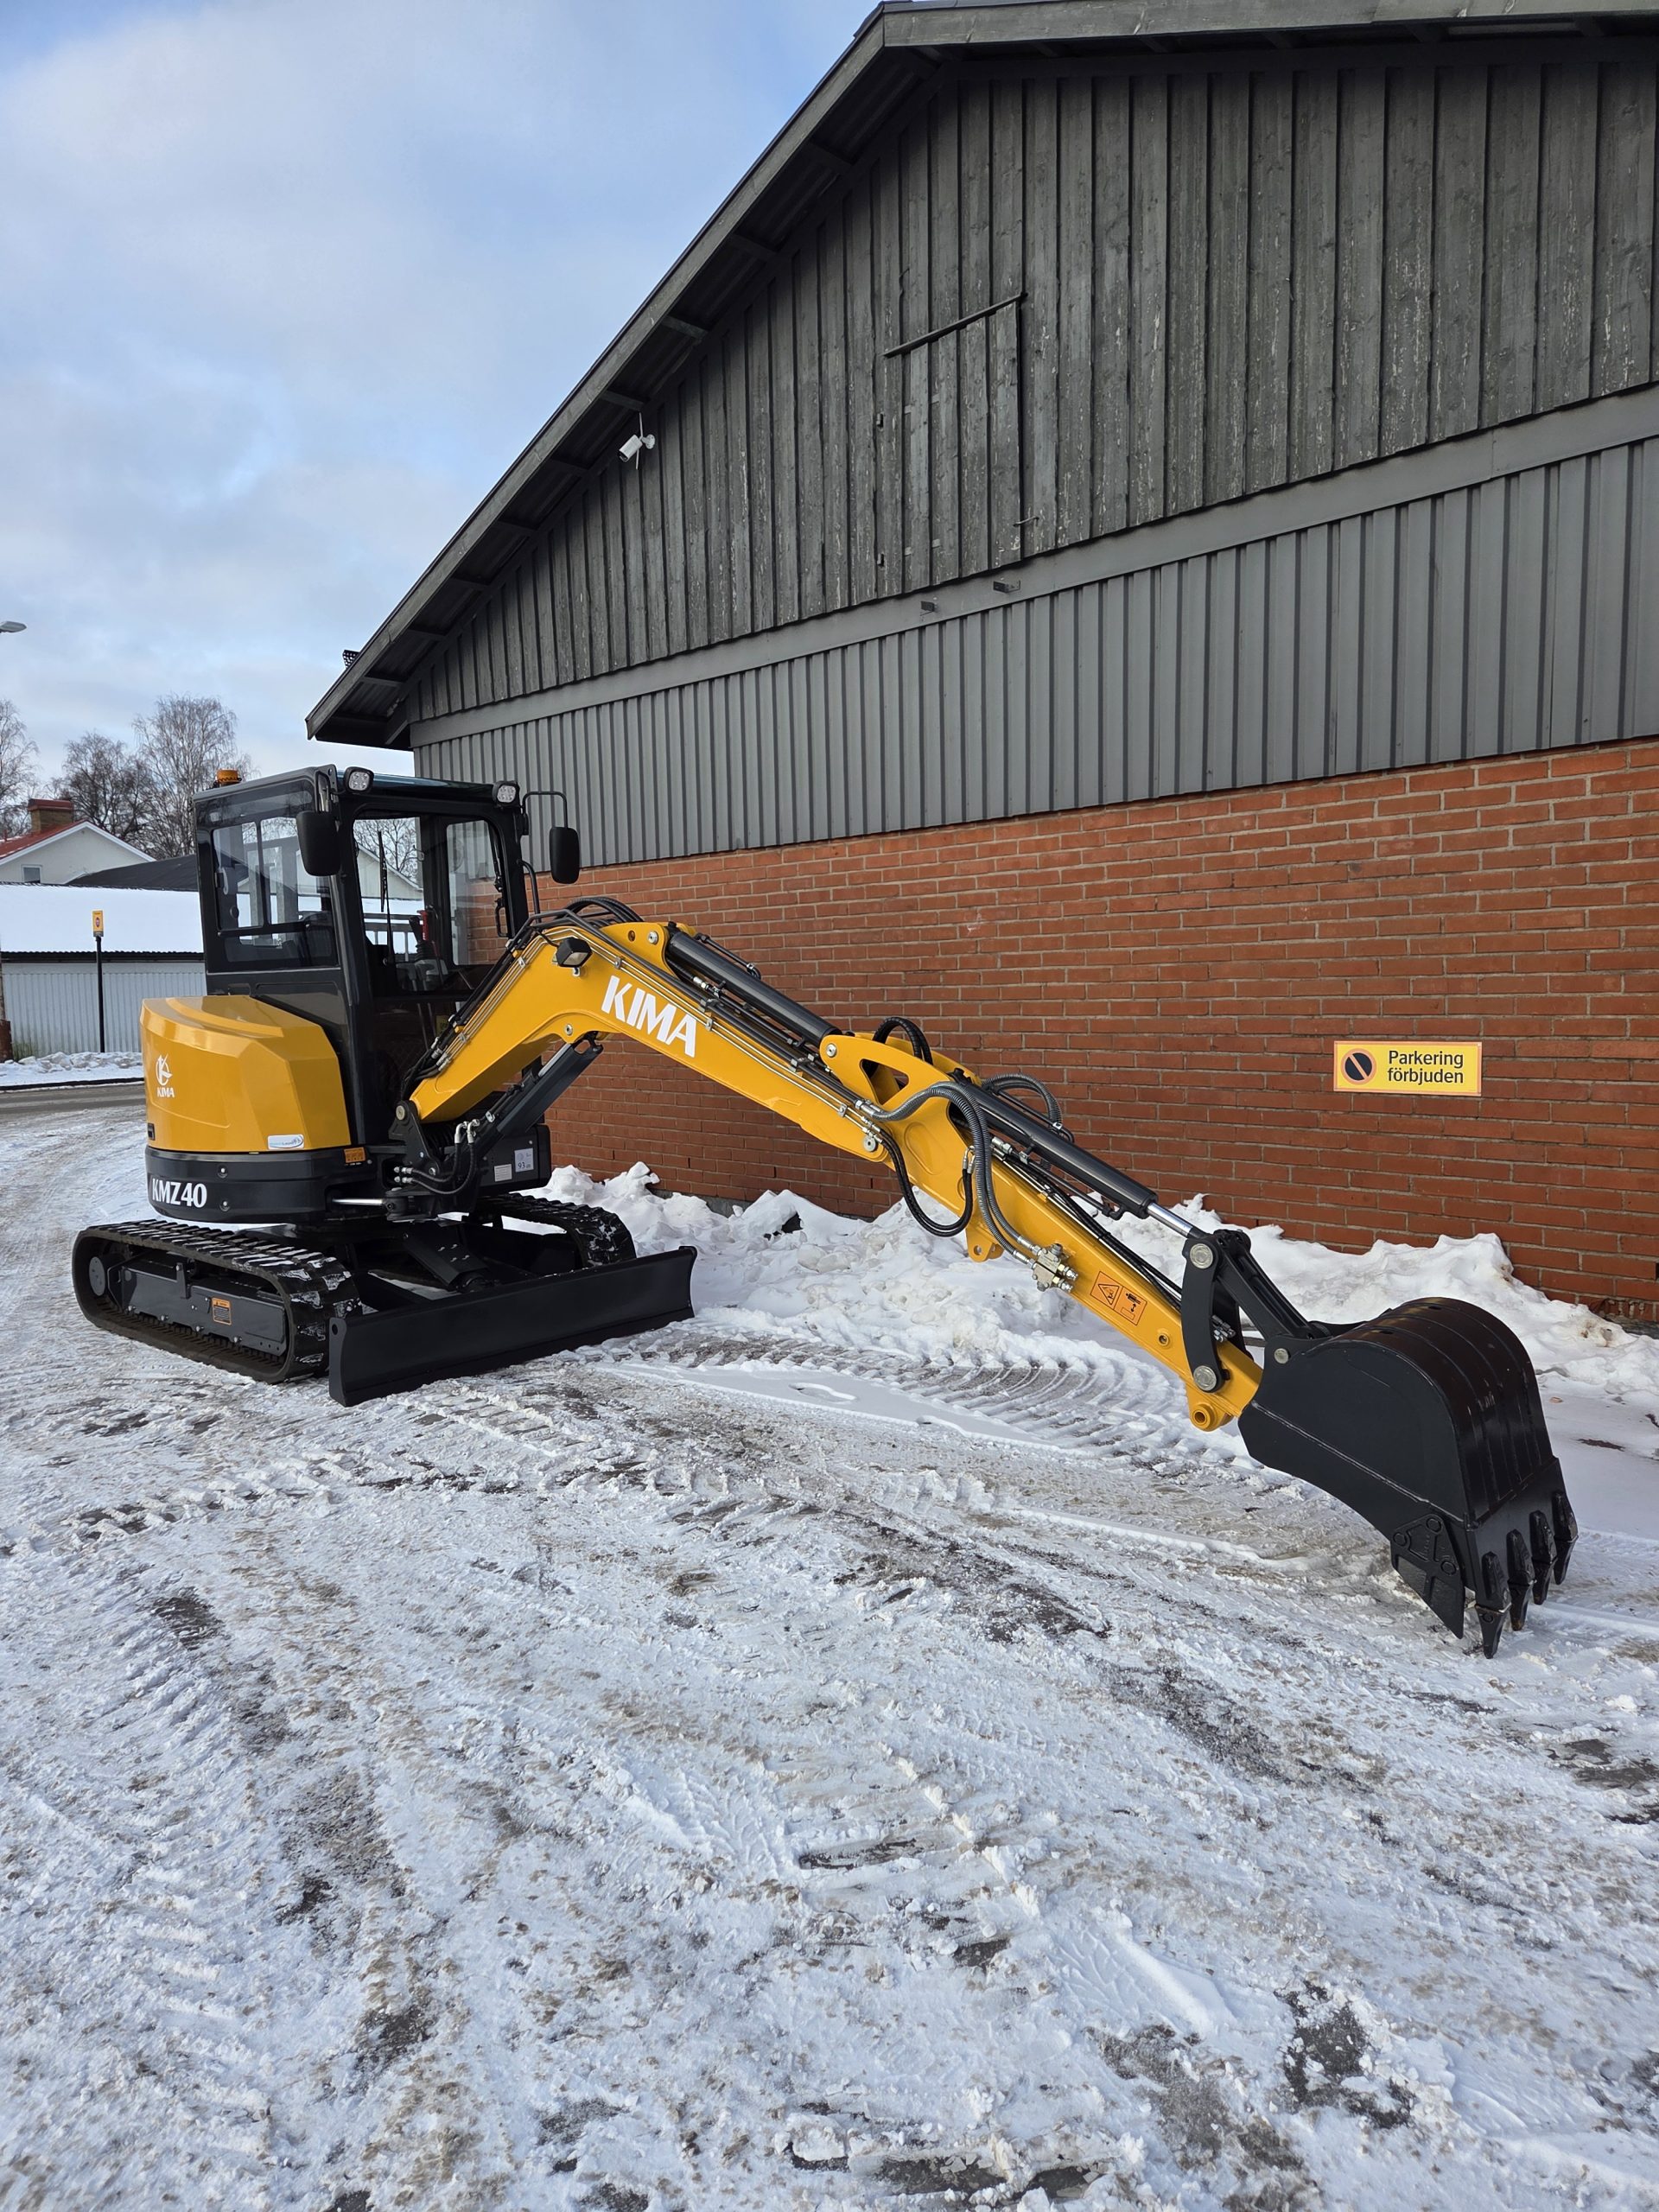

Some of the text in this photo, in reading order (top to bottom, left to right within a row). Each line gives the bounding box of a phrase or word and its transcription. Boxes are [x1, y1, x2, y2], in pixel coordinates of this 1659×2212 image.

[601, 975, 696, 1058] KIMA
[1389, 1051, 1464, 1068] Parkering
[1388, 1067, 1464, 1085] förbjuden
[156, 1087, 175, 1098] KIMA
[152, 1178, 207, 1208] KMZ40
